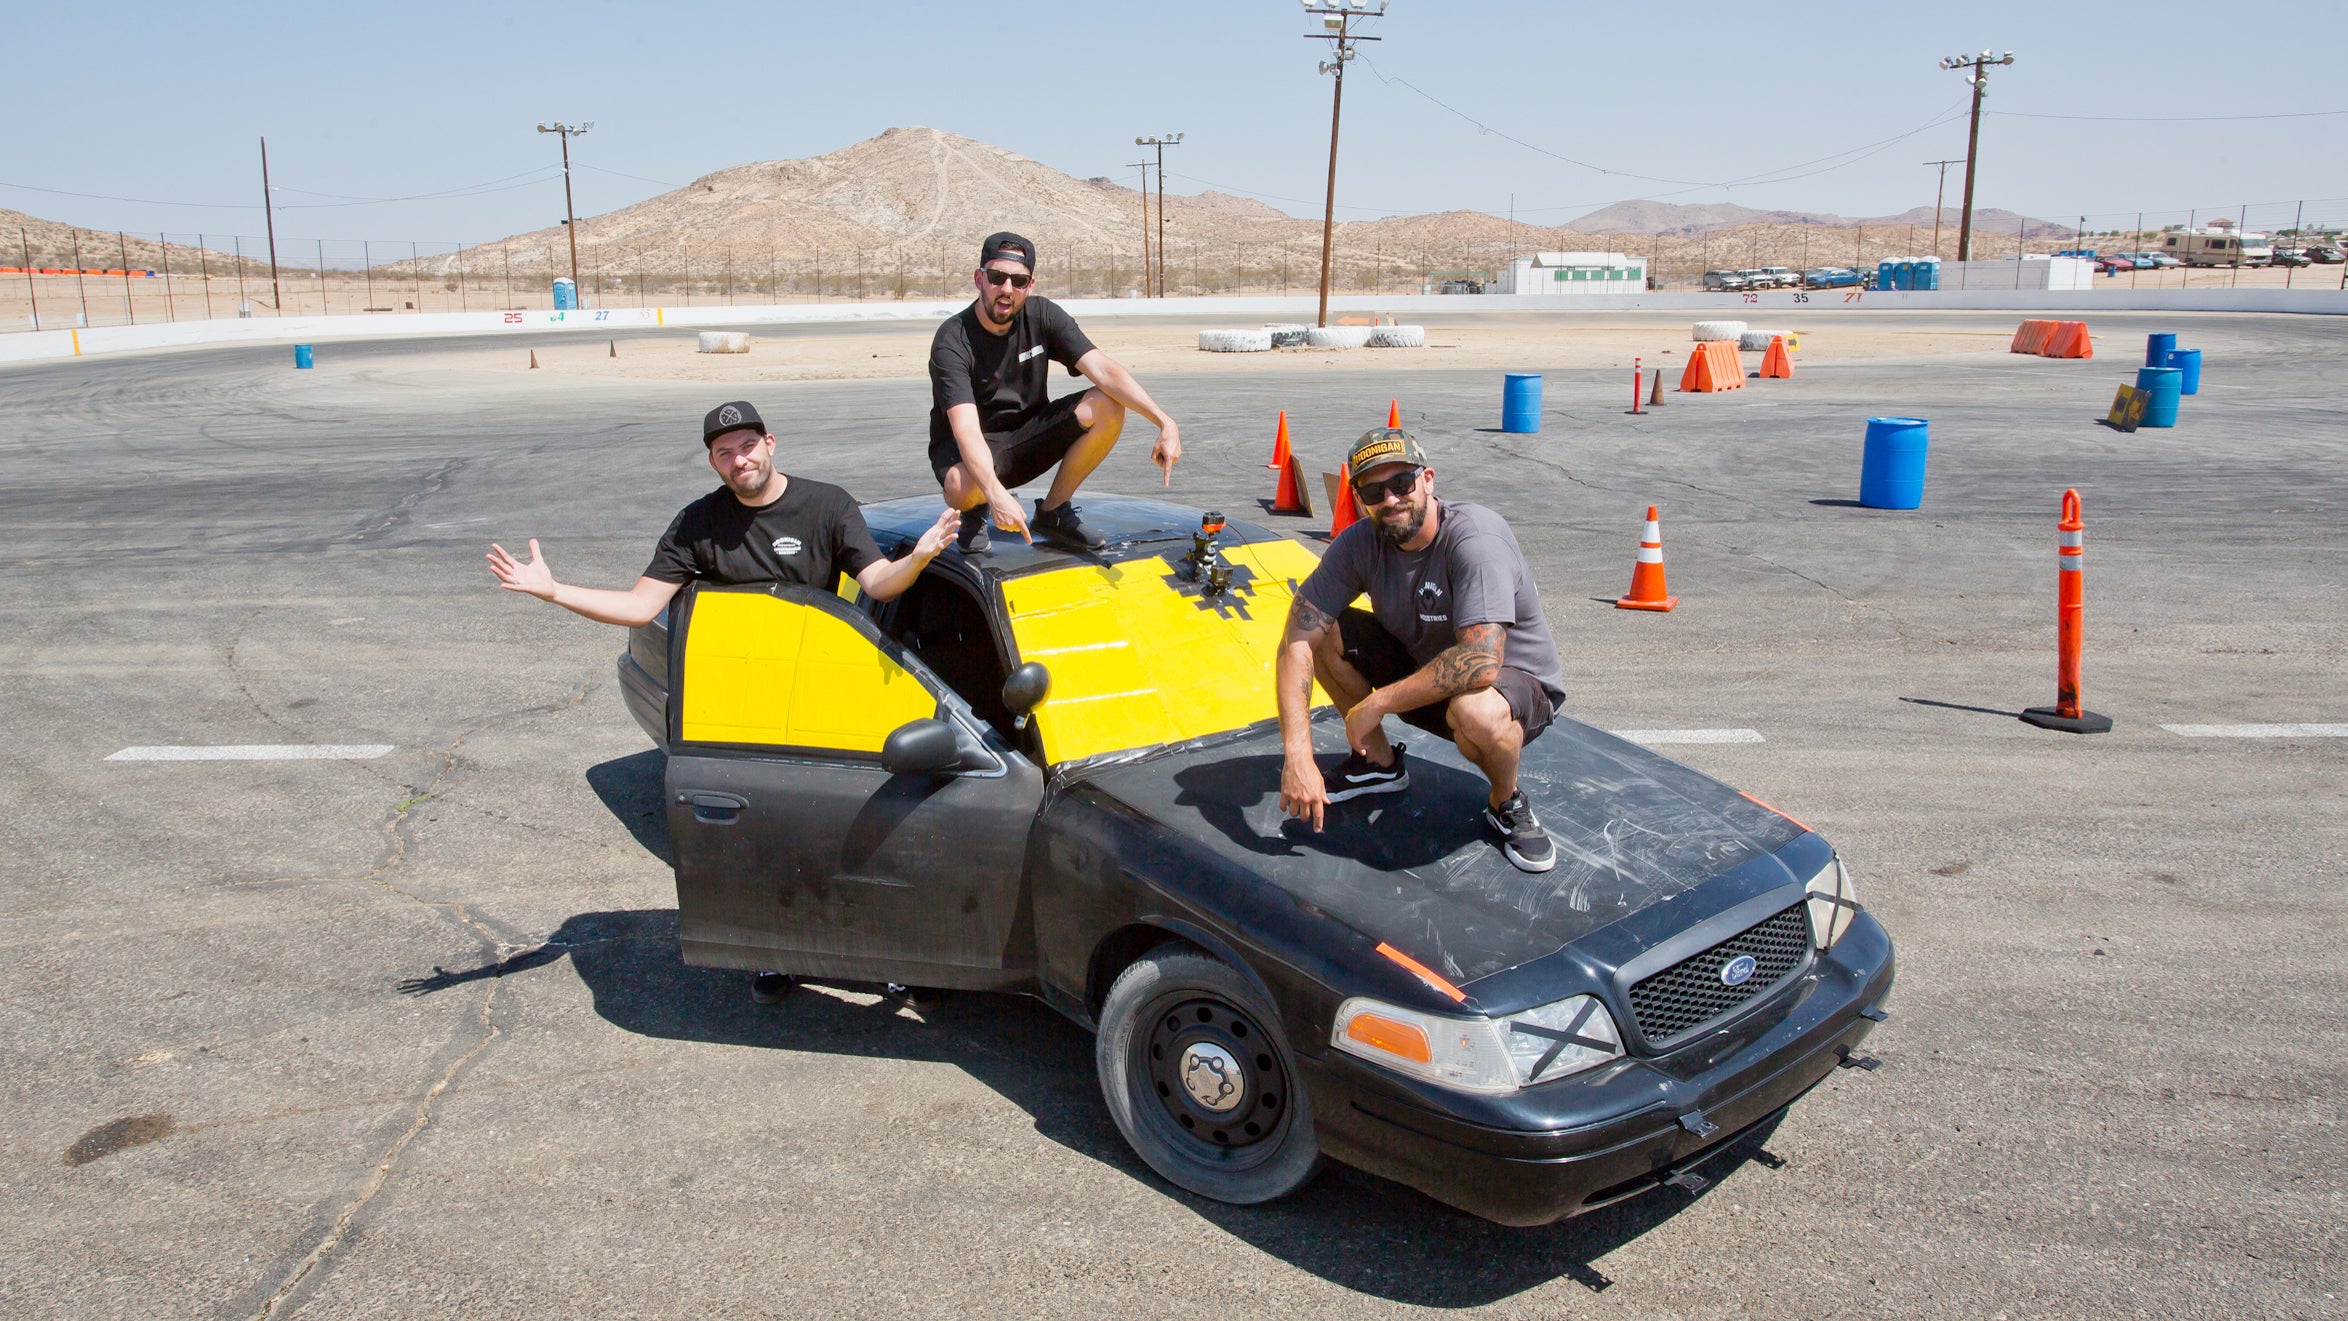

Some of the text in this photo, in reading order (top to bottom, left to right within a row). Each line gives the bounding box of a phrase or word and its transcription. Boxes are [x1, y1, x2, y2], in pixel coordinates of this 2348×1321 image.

[1742, 293, 1758, 304] 72
[1793, 293, 1809, 303] 35
[504, 313, 523, 324] 25
[595, 310, 609, 321] 27
[1731, 962, 1750, 980] Ford
